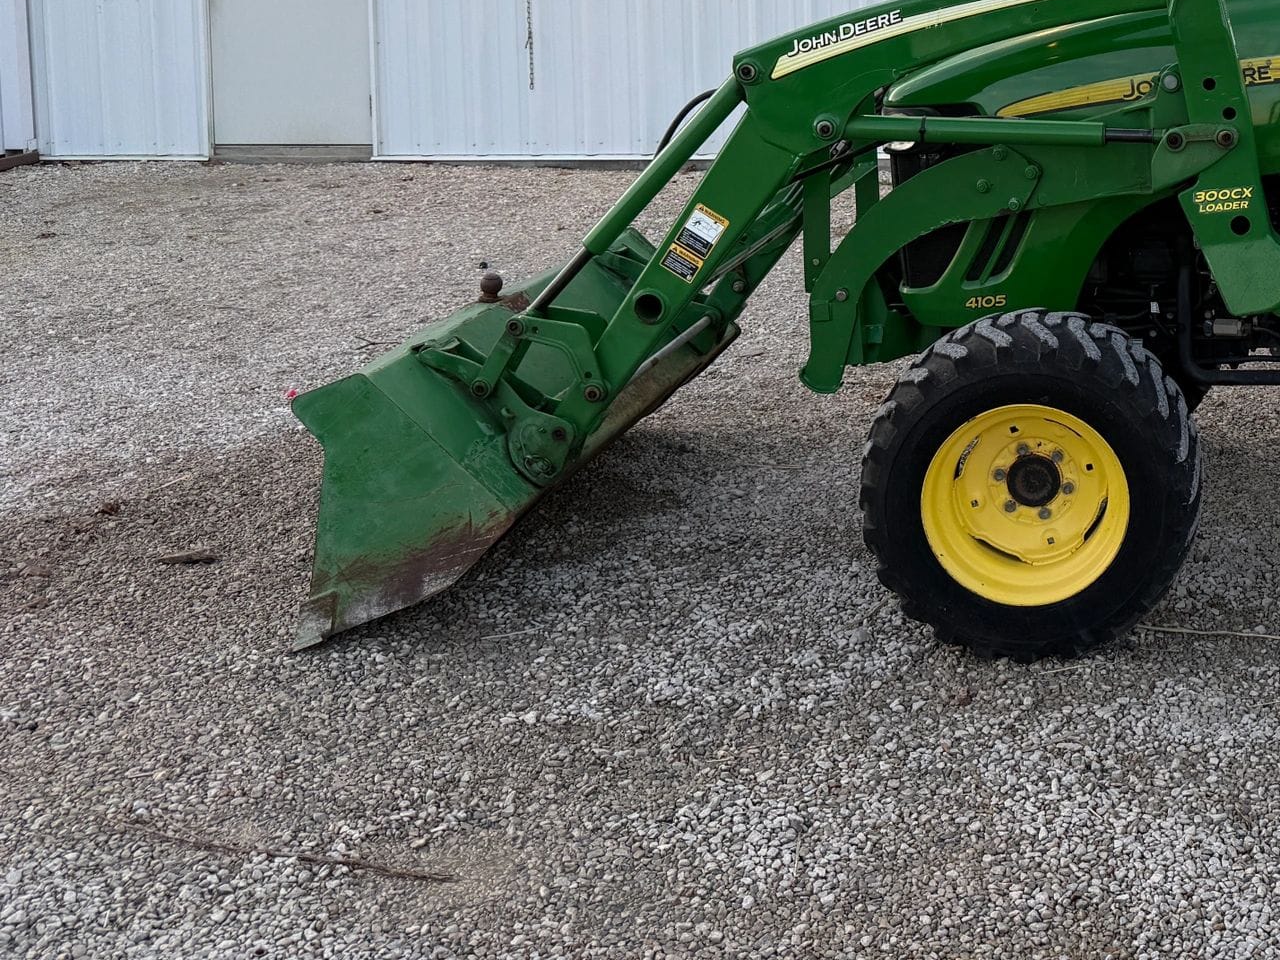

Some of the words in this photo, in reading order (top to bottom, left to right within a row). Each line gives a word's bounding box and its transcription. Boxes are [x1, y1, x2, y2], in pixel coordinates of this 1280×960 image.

[787, 30, 837, 57] JOHN
[839, 9, 902, 40] DEERE
[1195, 186, 1253, 203] 300CX
[1199, 200, 1249, 213] LOADER
[704, 207, 726, 225] WARNING
[678, 248, 700, 265] WARNING
[965, 294, 1007, 309] 4105
